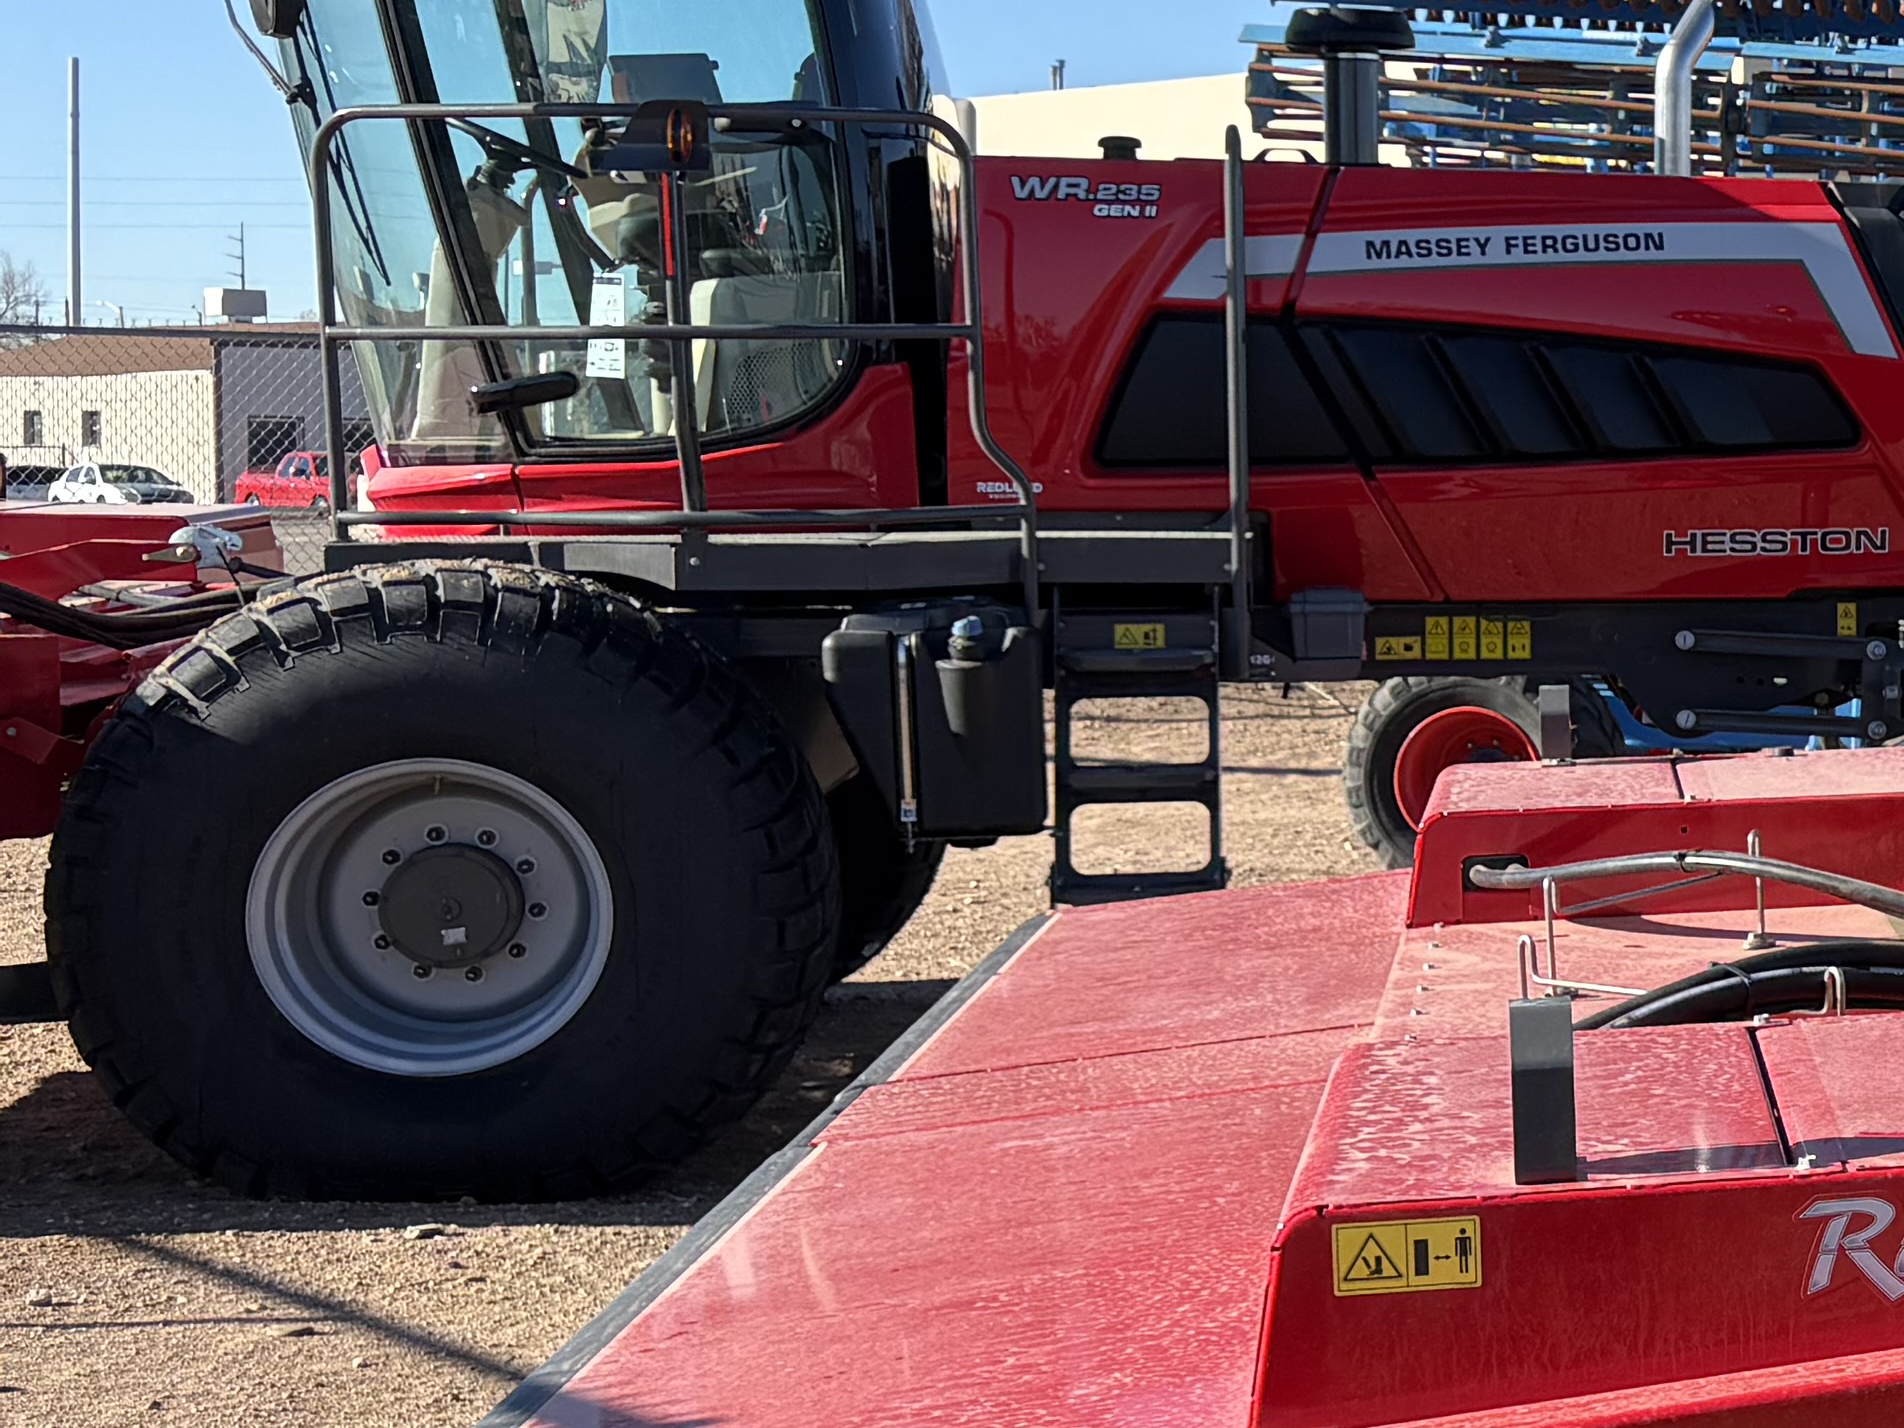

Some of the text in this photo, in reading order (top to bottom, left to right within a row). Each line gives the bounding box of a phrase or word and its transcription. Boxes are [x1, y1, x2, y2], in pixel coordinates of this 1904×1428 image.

[1010, 175, 1162, 201] WR.235
[1092, 204, 1158, 218] GEN II
[1365, 232, 1665, 260] MASSEY FERGUSON
[1663, 527, 1889, 556] HESSTON
